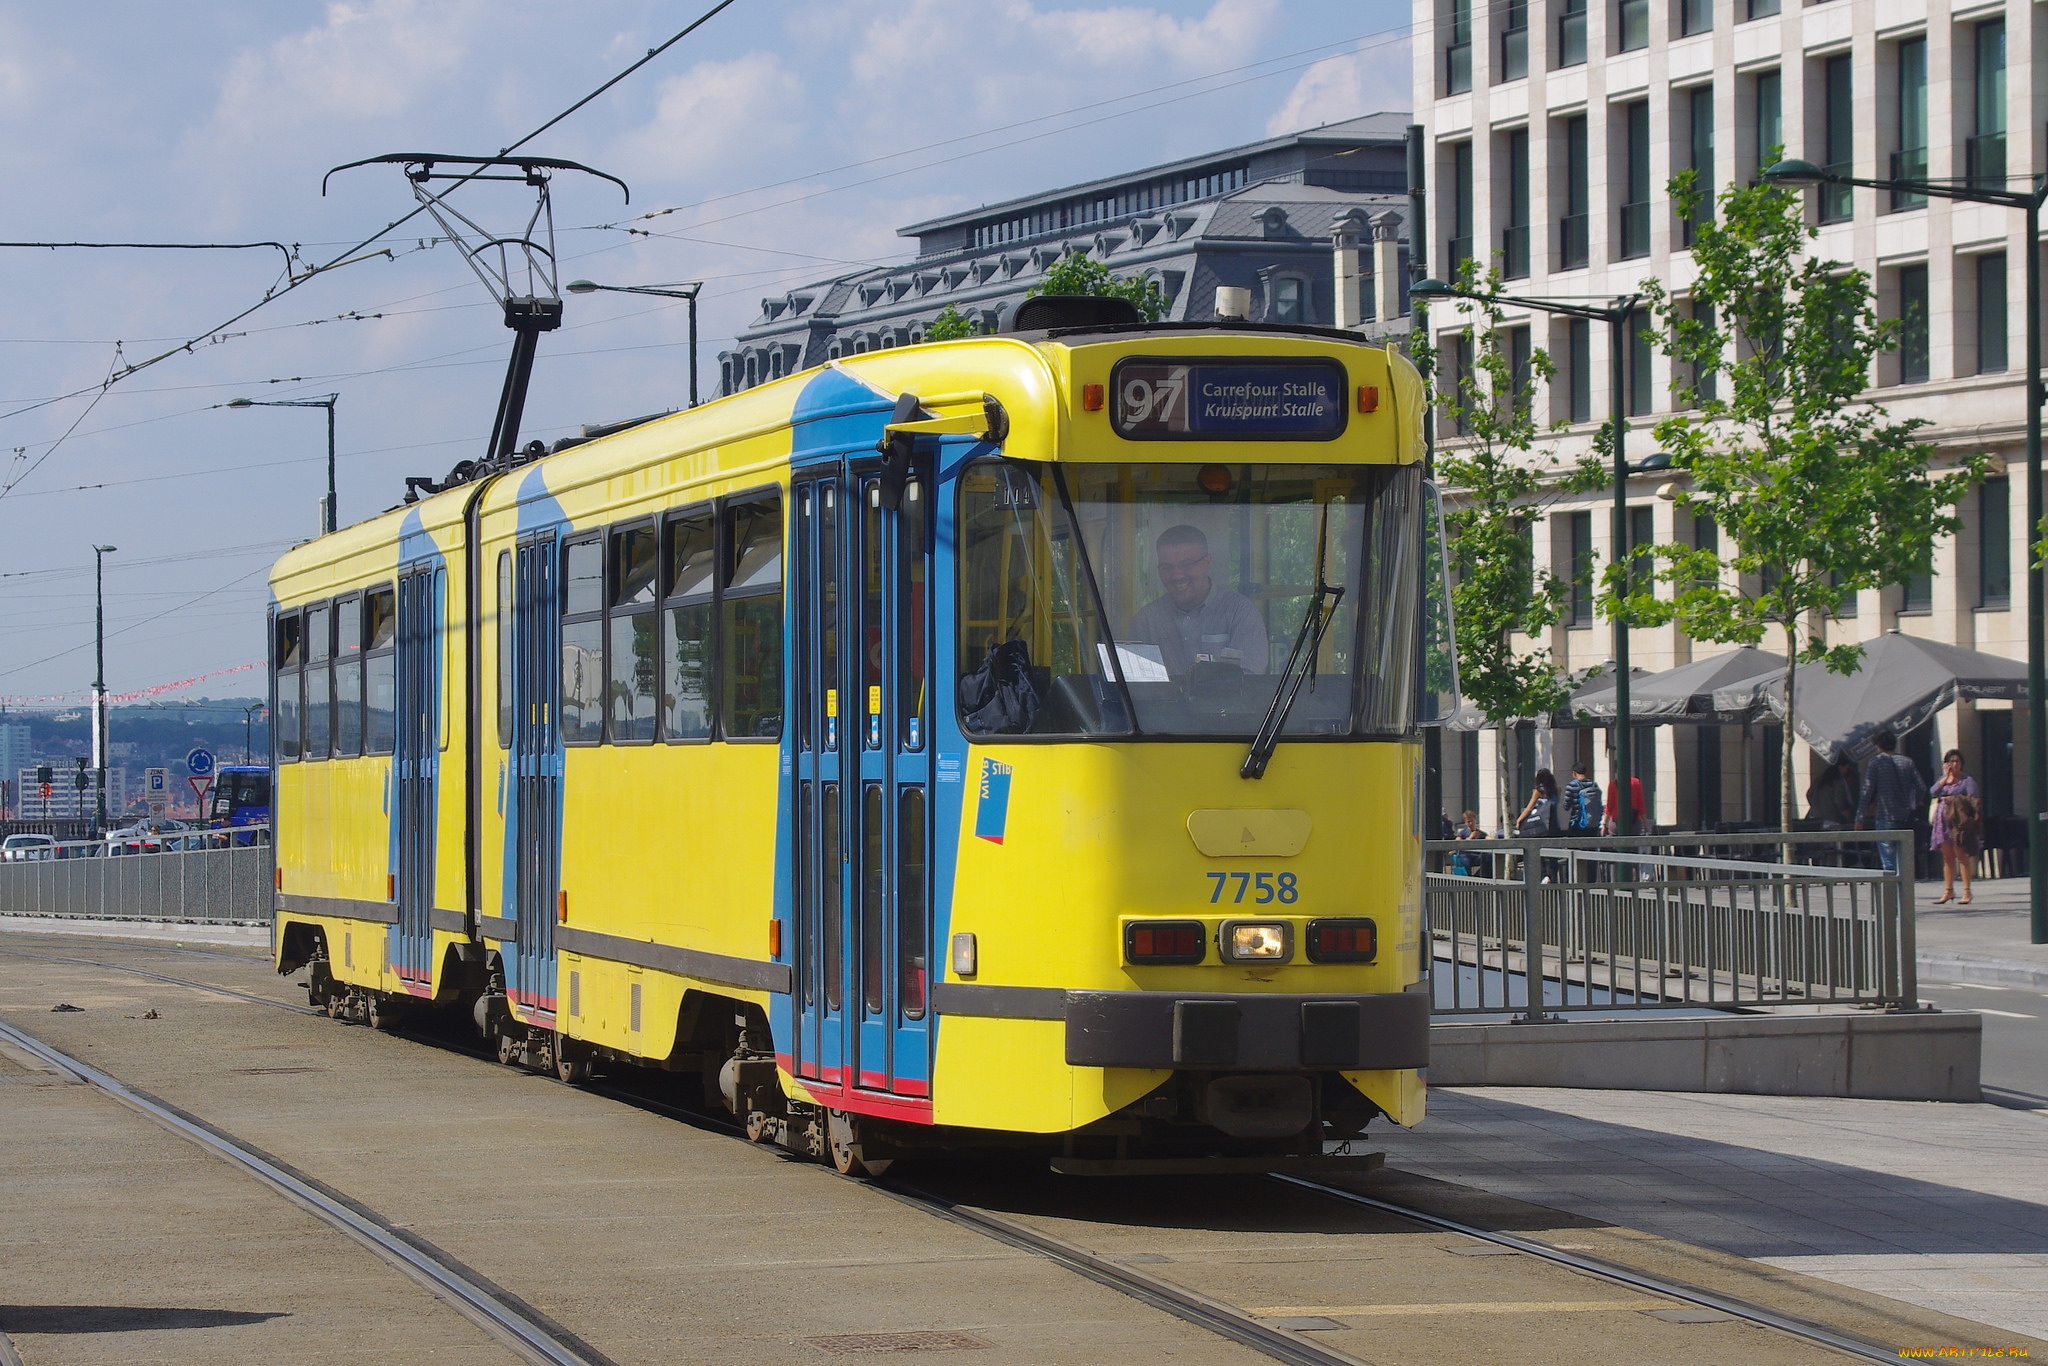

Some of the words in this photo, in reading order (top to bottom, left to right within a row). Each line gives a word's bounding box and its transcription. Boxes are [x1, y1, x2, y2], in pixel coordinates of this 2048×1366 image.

[1203, 382, 1278, 400] Carrefour
[1283, 382, 1326, 397] Stalle
[1124, 380, 1184, 423] 97
[1204, 403, 1278, 420] Kruispunt
[1282, 402, 1324, 417] Stalle
[992, 763, 1012, 776] STIB
[1206, 872, 1299, 904] 7758
